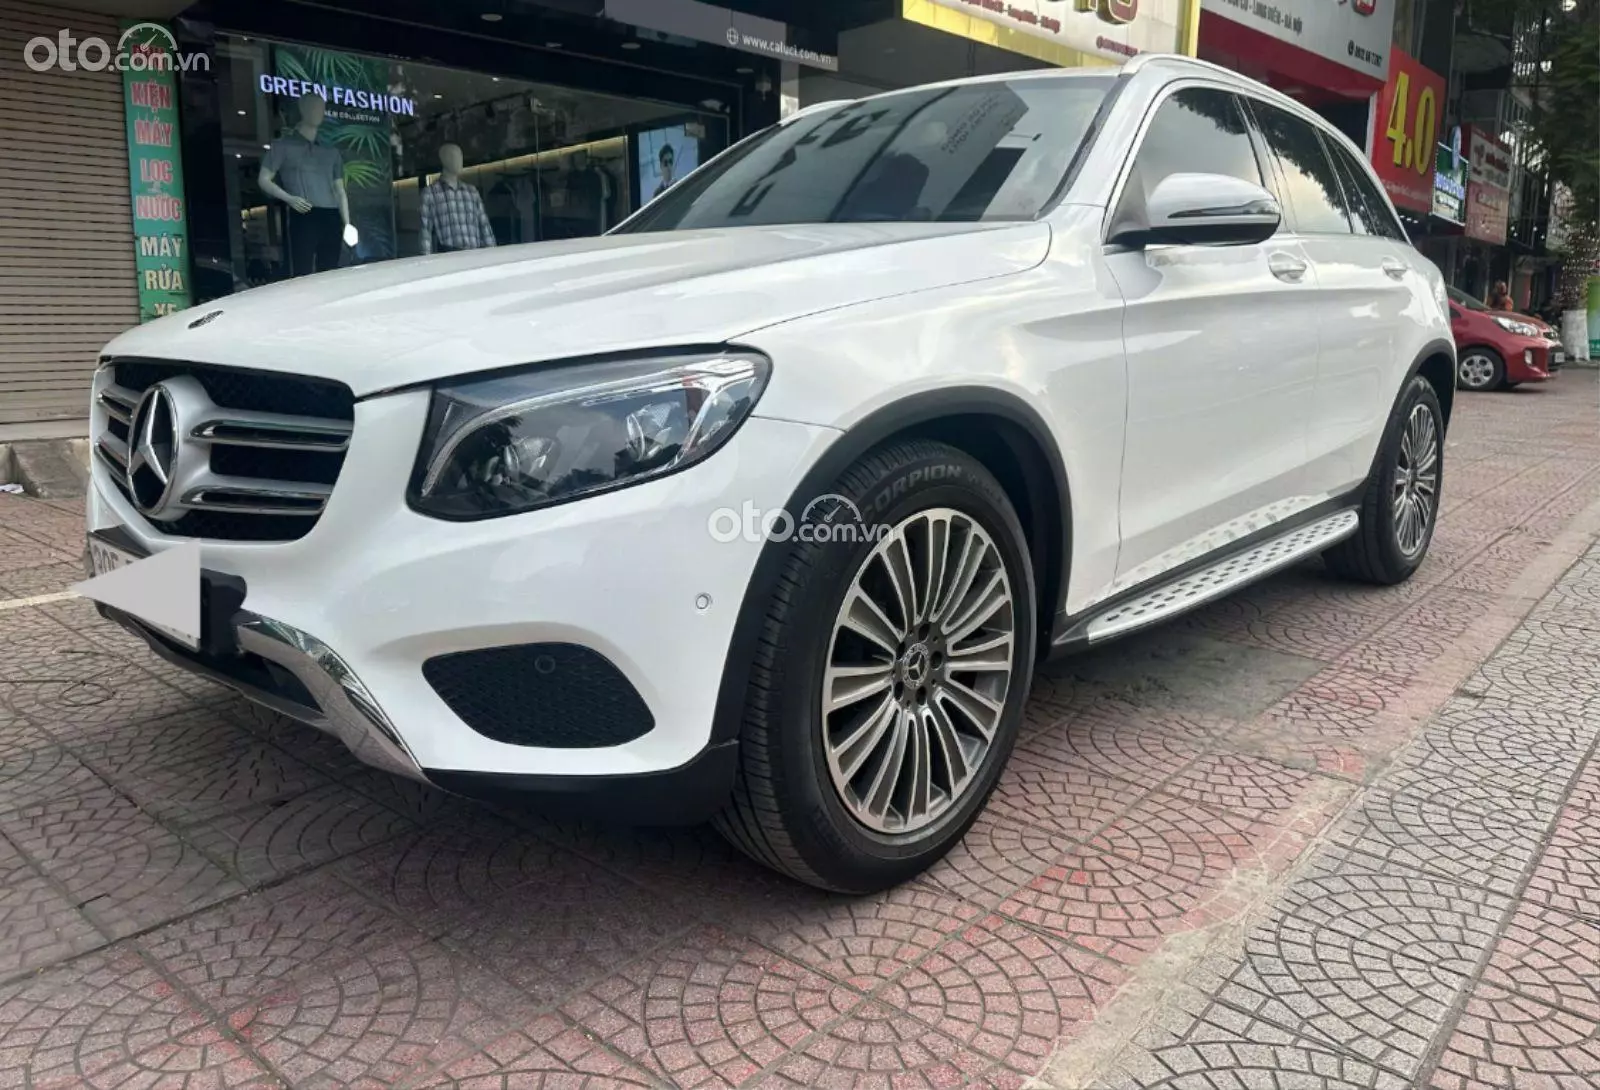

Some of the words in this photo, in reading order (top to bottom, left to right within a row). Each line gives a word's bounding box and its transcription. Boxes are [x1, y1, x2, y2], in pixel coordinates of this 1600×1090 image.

[742, 33, 832, 65] www.caluci.com.vn
[259, 74, 328, 103] GREEN
[332, 86, 415, 117] FASHION
[134, 115, 173, 148] MÁY
[1387, 71, 1436, 176] 4.0
[140, 232, 183, 258] MÁY
[144, 263, 184, 291] RỬA
